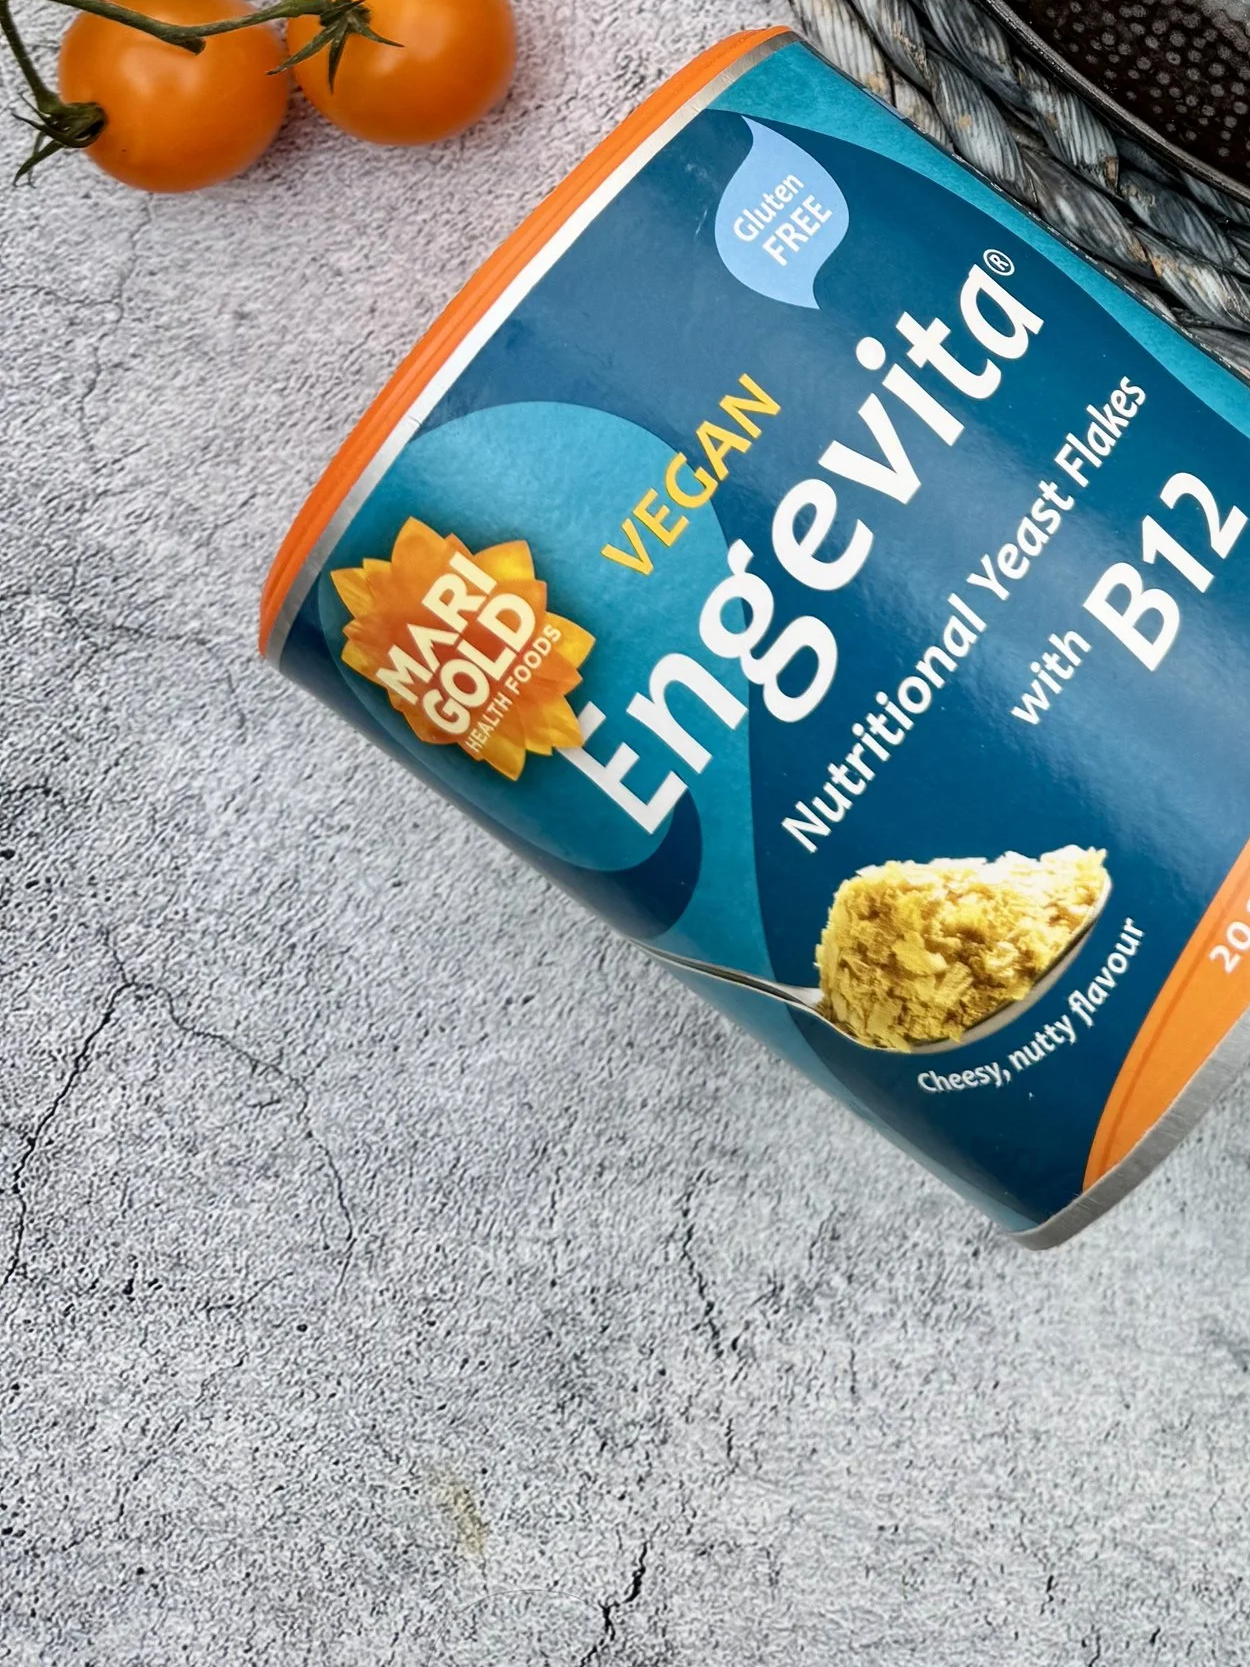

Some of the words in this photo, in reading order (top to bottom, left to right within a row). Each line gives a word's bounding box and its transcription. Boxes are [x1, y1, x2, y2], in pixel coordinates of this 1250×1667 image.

[733, 174, 805, 242] Gluten
[762, 195, 832, 266] FREE
[600, 372, 782, 576] VEGAN
[375, 551, 497, 705] MARI
[422, 593, 536, 735] GOLD
[781, 593, 987, 853] Nutritional
[967, 480, 1074, 601] Yeast
[1054, 376, 1146, 487] Flakes
[1011, 630, 1092, 726] with
[1082, 472, 1248, 672] B12
[464, 691, 514, 753] HEALTH
[504, 624, 562, 694] FOODS
[917, 1061, 1011, 1092] Cheesy,
[1007, 1015, 1076, 1072] nutty
[1067, 917, 1145, 1027] flavour
